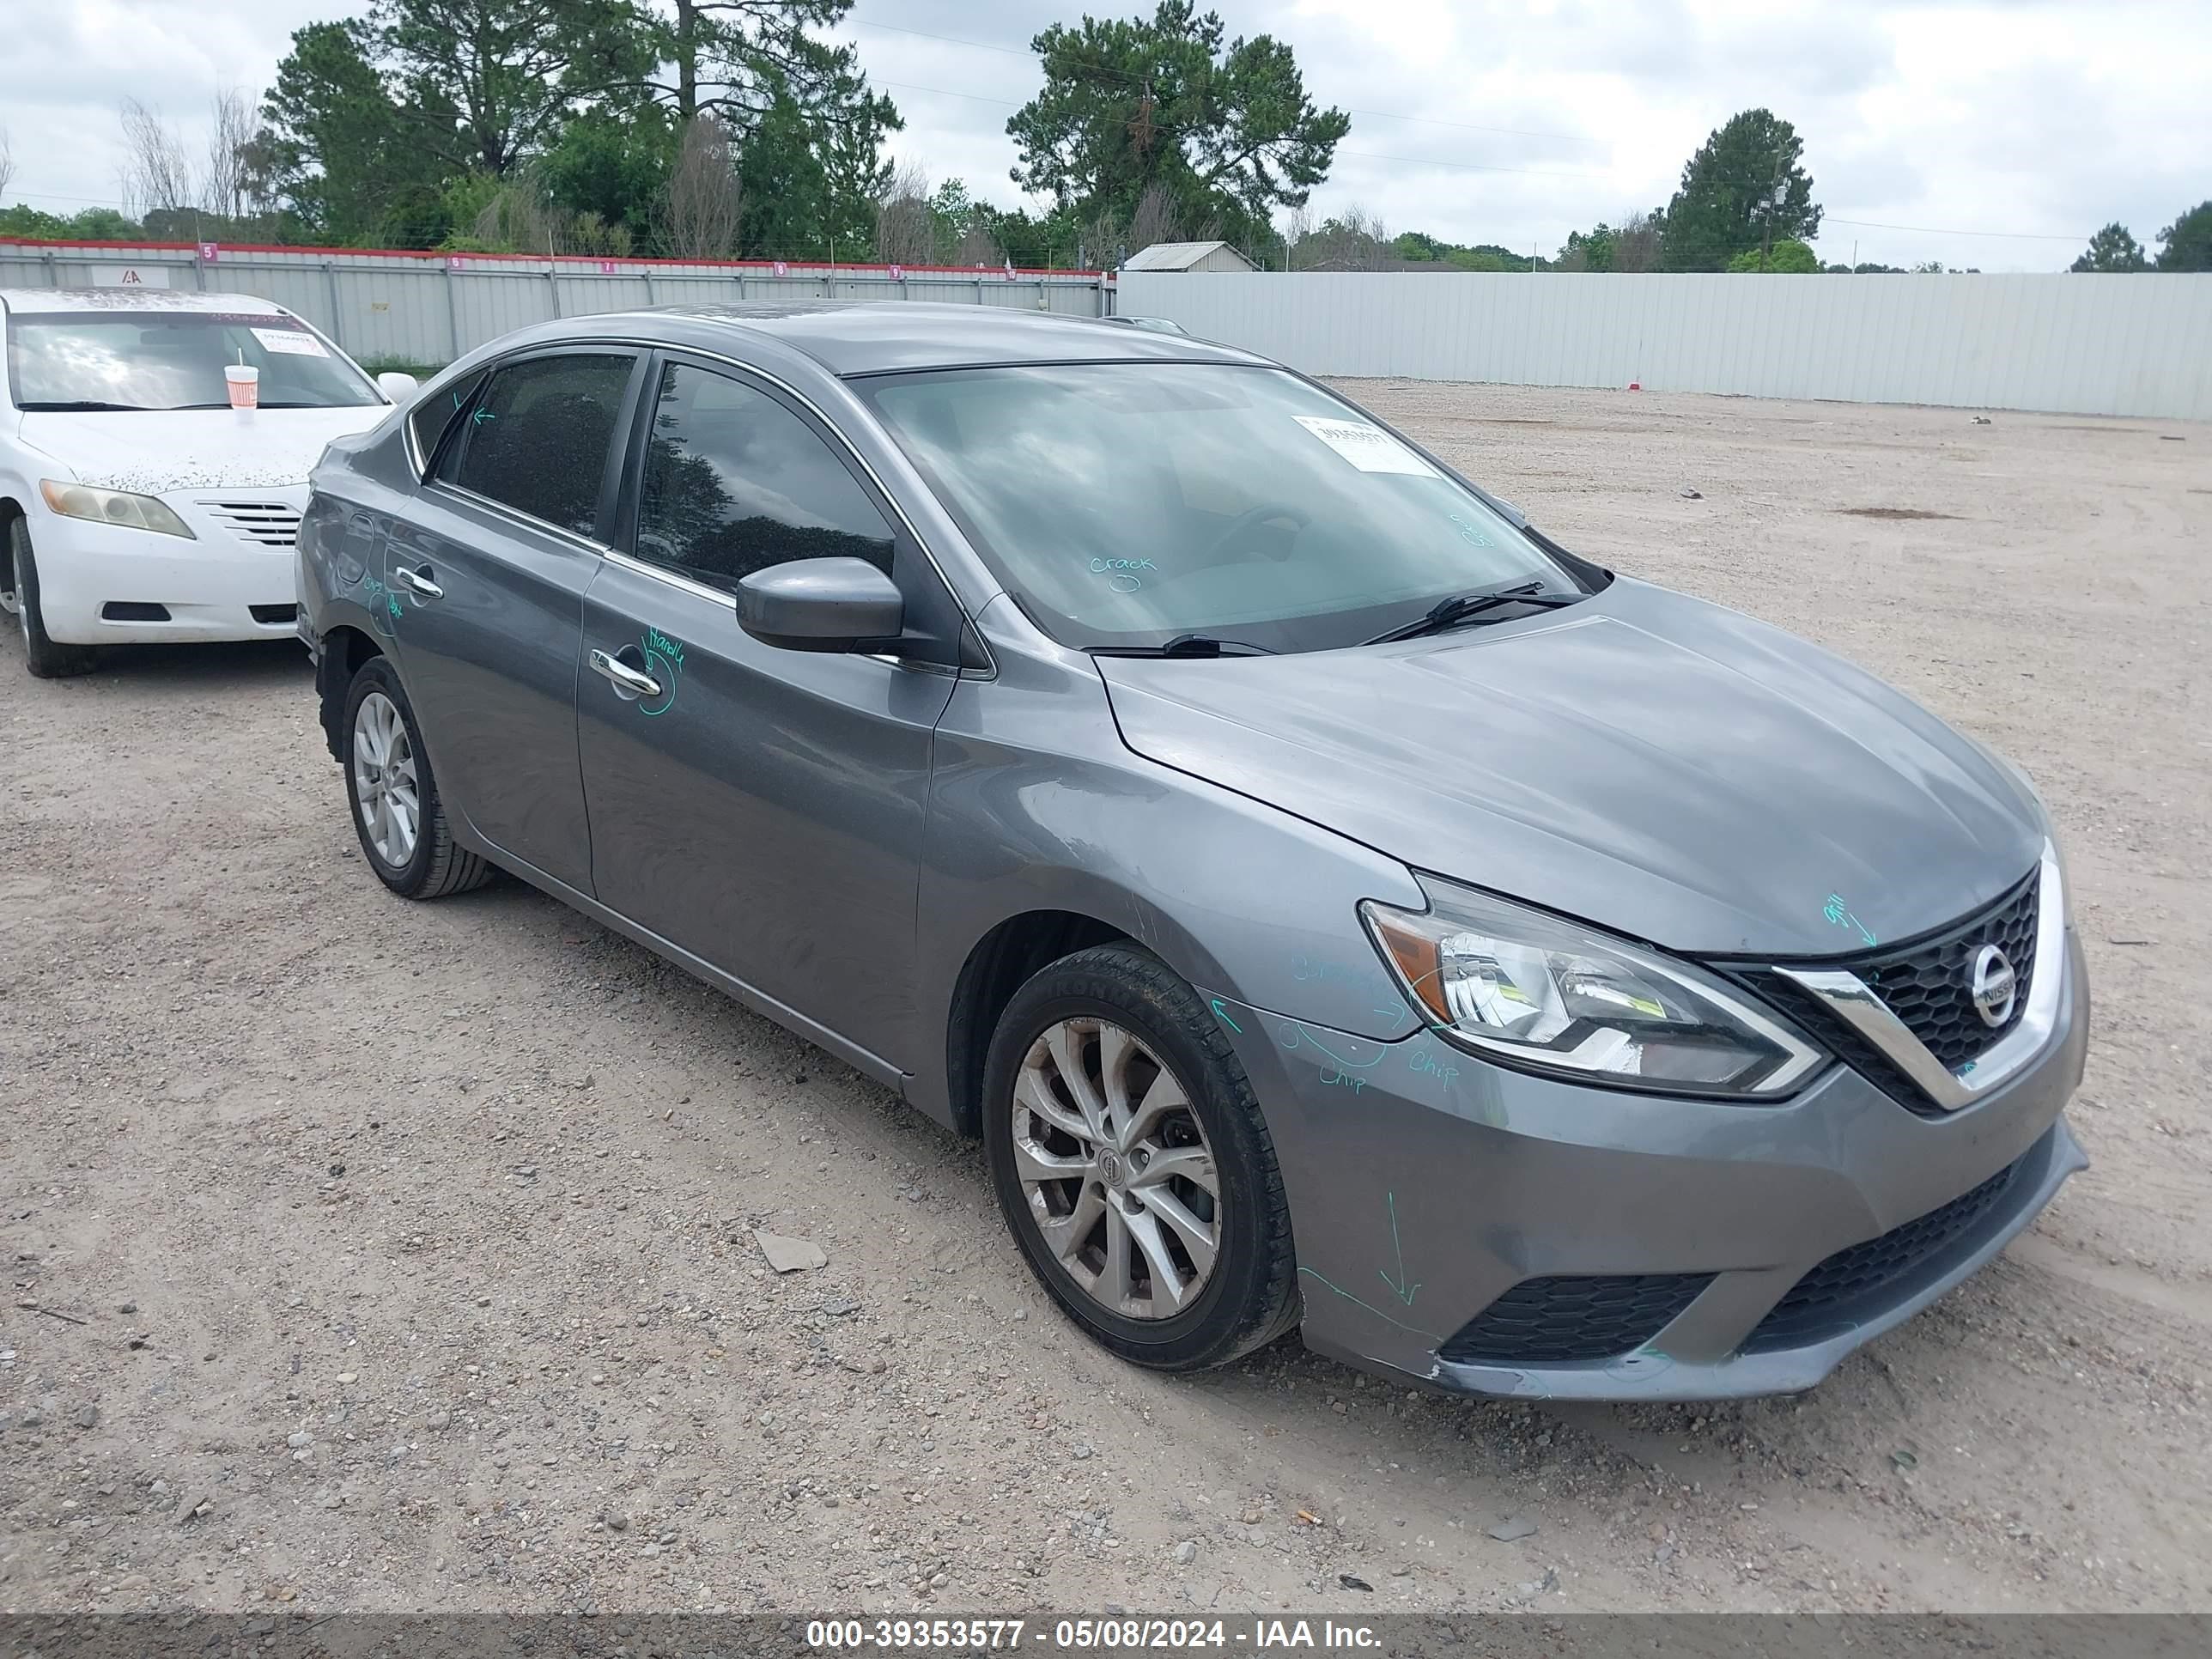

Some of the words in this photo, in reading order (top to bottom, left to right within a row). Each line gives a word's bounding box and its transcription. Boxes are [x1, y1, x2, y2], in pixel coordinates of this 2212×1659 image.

[204, 246, 213, 258] 5
[1984, 979, 2015, 1004] NISSA
[1318, 1060, 1368, 1096] Chip
